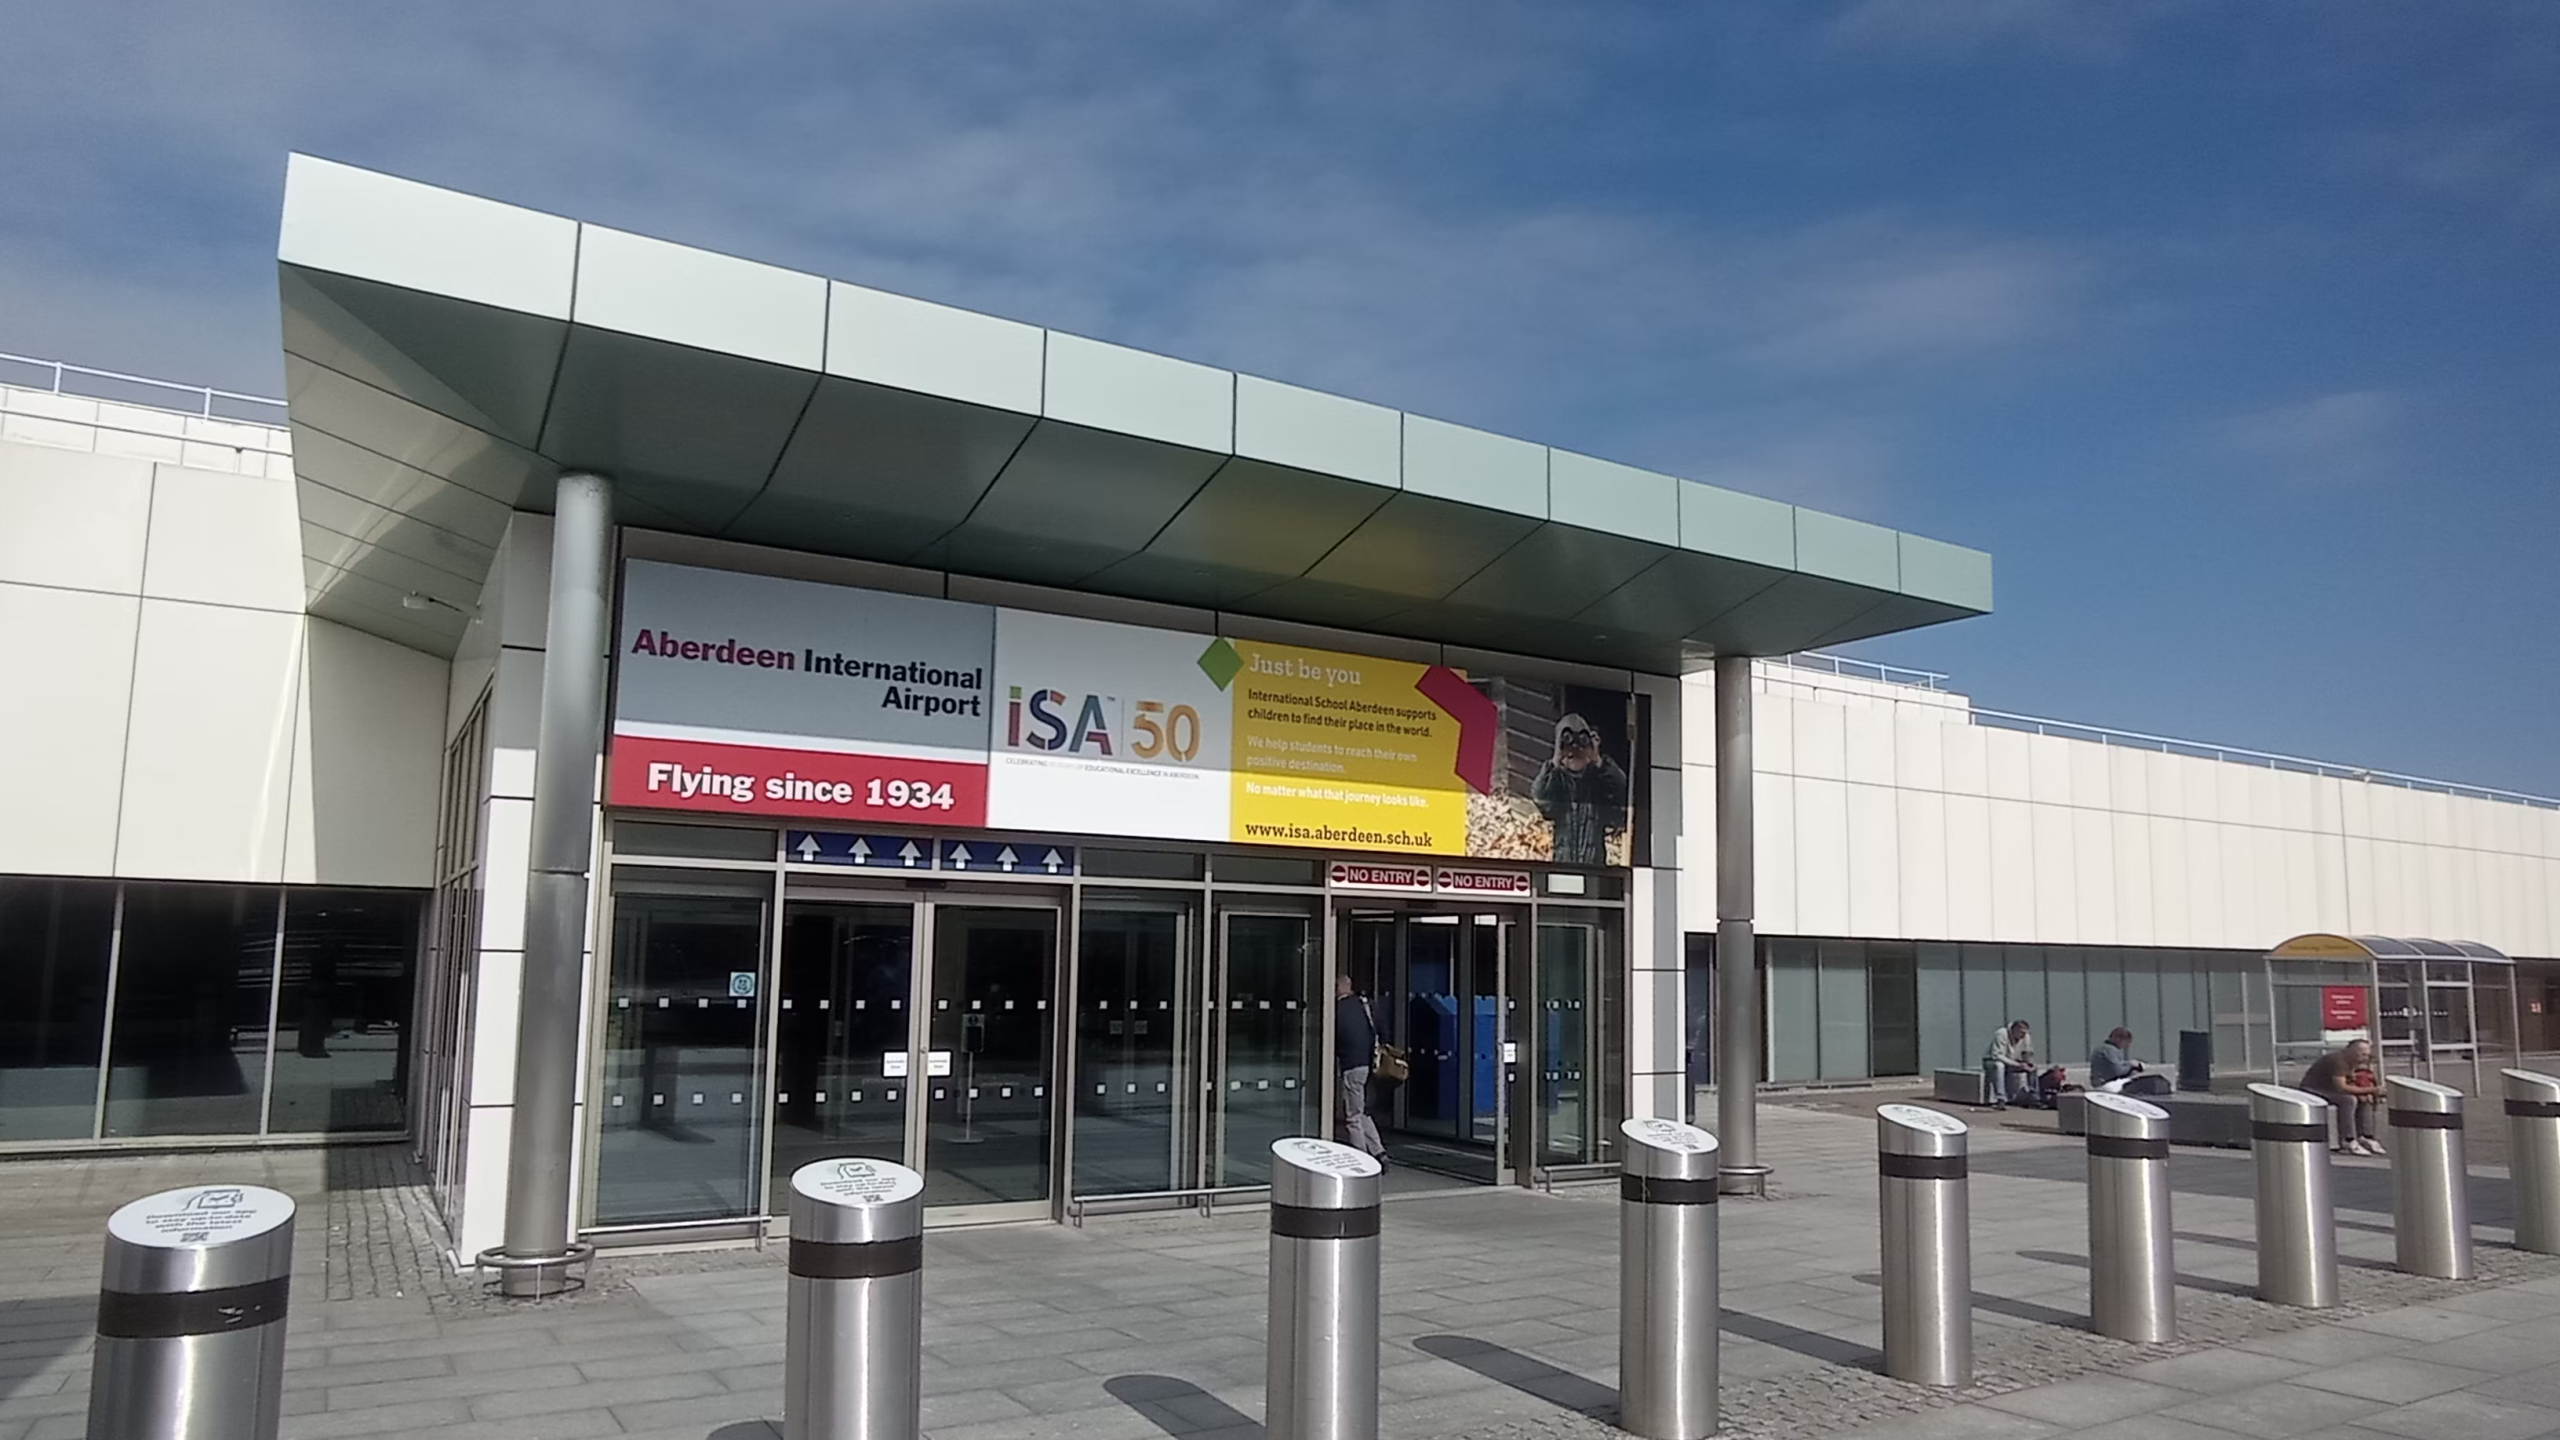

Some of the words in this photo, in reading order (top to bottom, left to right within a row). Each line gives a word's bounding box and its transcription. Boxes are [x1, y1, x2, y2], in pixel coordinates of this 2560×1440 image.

[632, 629, 795, 671] Aberdeen
[804, 649, 982, 690] International
[1250, 653, 1293, 676] Just
[1298, 659, 1321, 679] be
[1326, 668, 1360, 687] you
[882, 686, 981, 717] Airport
[1249, 689, 1314, 706] International
[1315, 697, 1347, 711] School
[1349, 700, 1394, 716] Aberdeen
[1396, 706, 1436, 722] supports
[1131, 700, 1201, 762] 50
[1248, 708, 1290, 723] children
[1291, 713, 1301, 723] to
[1303, 713, 1322, 726] find
[1325, 716, 1346, 728] their
[1349, 717, 1374, 732] place
[1376, 721, 1384, 731] in
[1385, 722, 1400, 734] the
[1403, 724, 1432, 737] world.
[1247, 736, 1263, 749] We
[1265, 737, 1287, 752] help
[1289, 740, 1332, 754] students
[1334, 744, 1344, 755] to
[1346, 745, 1372, 759] reach
[1374, 748, 1396, 761] their
[1398, 752, 1417, 762] own
[1084, 765, 1125, 774] EDUCATIONAL
[1125, 768, 1161, 777] EXCELLENCE
[1169, 771, 1199, 779] ABERDEEN
[1247, 756, 1286, 770] positive
[1289, 758, 1345, 773] destination.
[648, 762, 755, 801] Flying
[766, 773, 852, 804] since
[866, 779, 954, 810] 1934
[1246, 783, 1263, 795] No
[1263, 784, 1297, 798] matter
[1298, 787, 1323, 799] what
[1324, 788, 1343, 800] that
[1344, 789, 1381, 804] journey
[1382, 791, 1407, 806] looks
[1409, 793, 1429, 807] like.
[1246, 823, 1432, 847] www.isa.aberdeen.sch.uk
[1350, 869, 1368, 882] NO
[1371, 870, 1412, 884] ENTRY
[1455, 874, 1472, 887] NO
[1475, 876, 1512, 889] ENTRY
